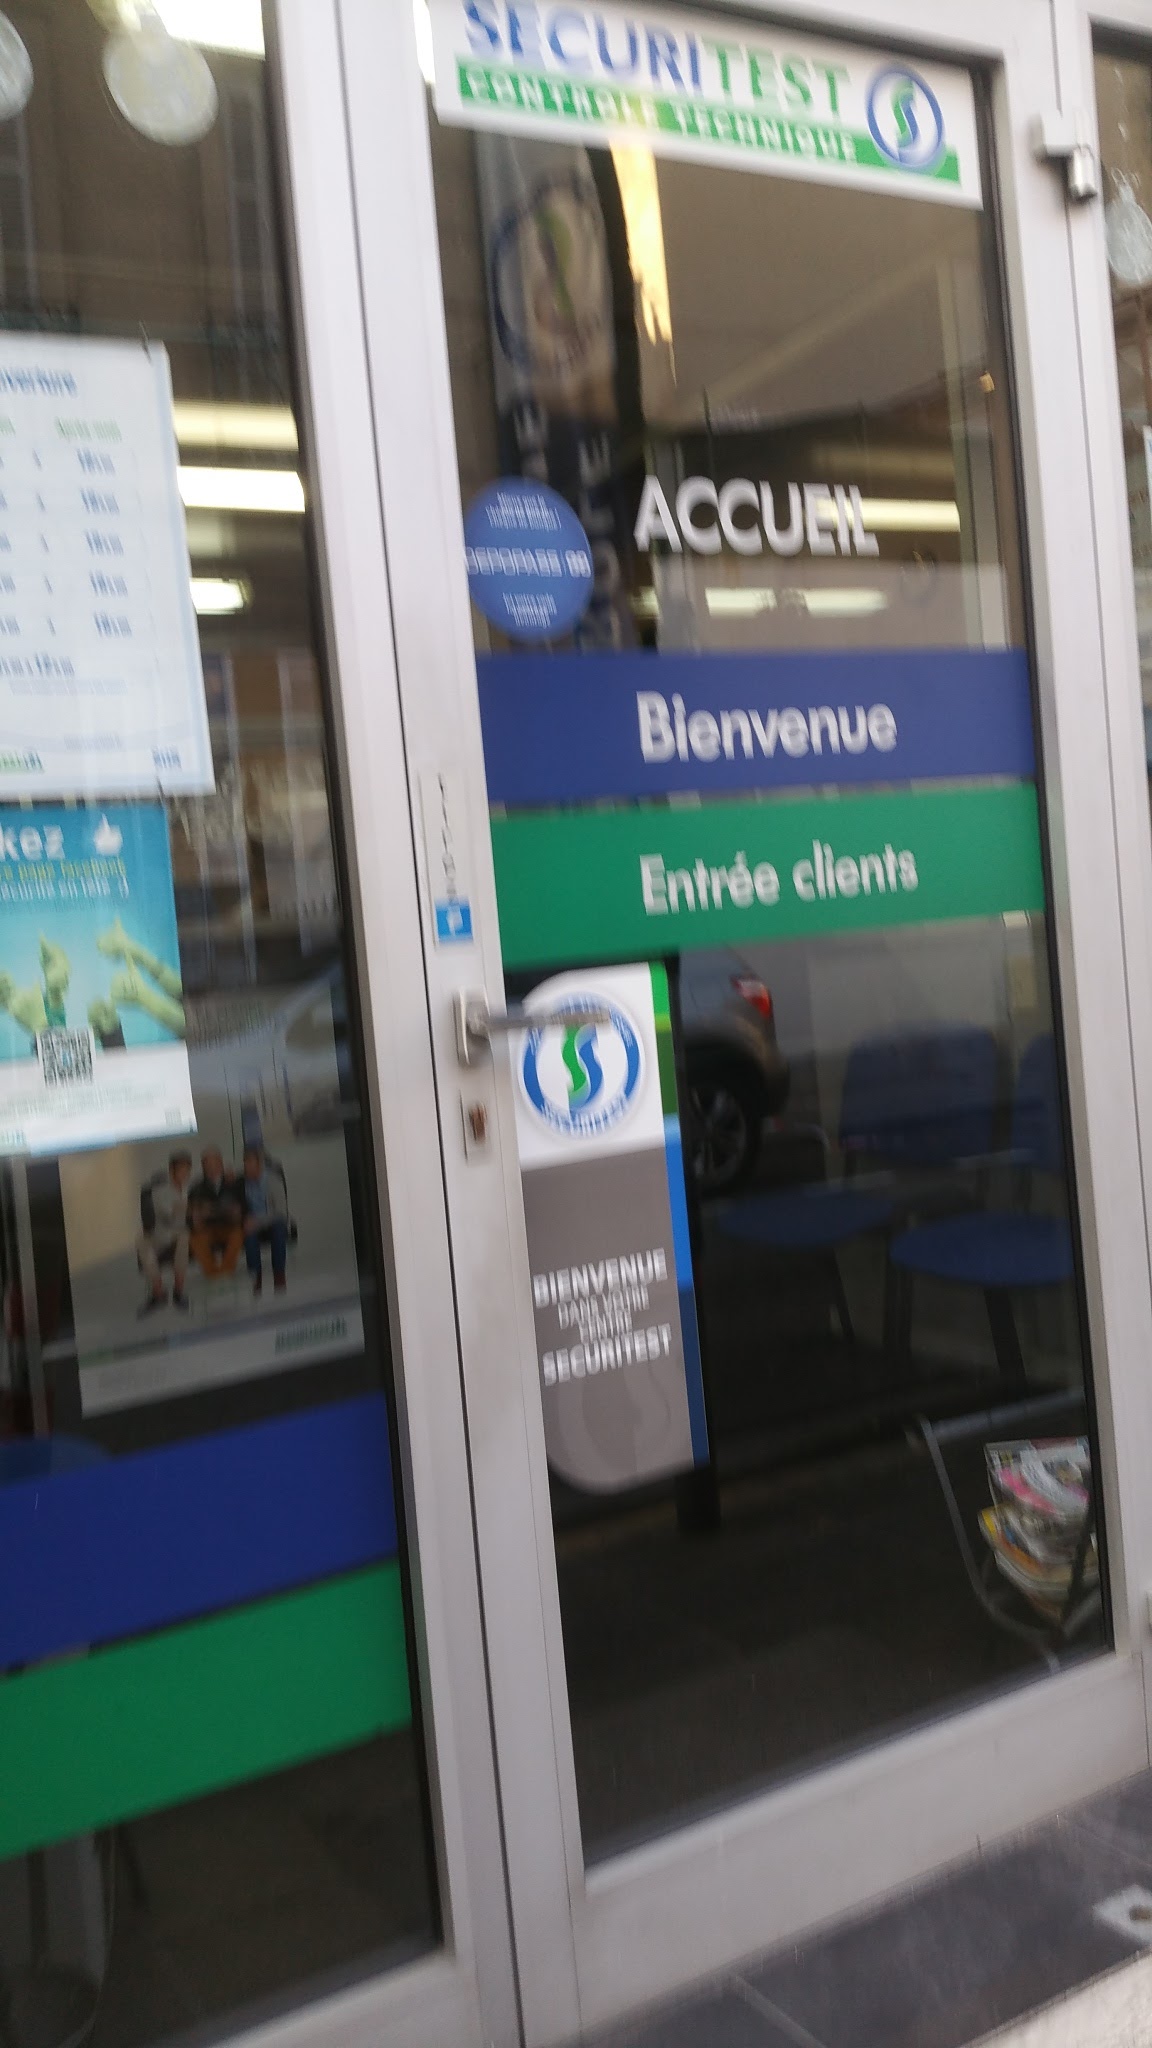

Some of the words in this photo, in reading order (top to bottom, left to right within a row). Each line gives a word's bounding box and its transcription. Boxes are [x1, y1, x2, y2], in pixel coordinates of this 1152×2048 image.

[463, 0, 850, 116] SECURITEST
[669, 99, 858, 166] TECHNIQUE
[633, 475, 879, 557] ACCUEIL
[636, 690, 897, 763] Bienvenue
[639, 850, 780, 916] Entrée
[792, 838, 919, 903] clients
[532, 1247, 668, 1310] BIENVENUE
[557, 1293, 601, 1330] DANS
[600, 1283, 650, 1327] VOTRE
[542, 1322, 672, 1387] SECURITEST
[577, 1308, 633, 1346] CENTRE
